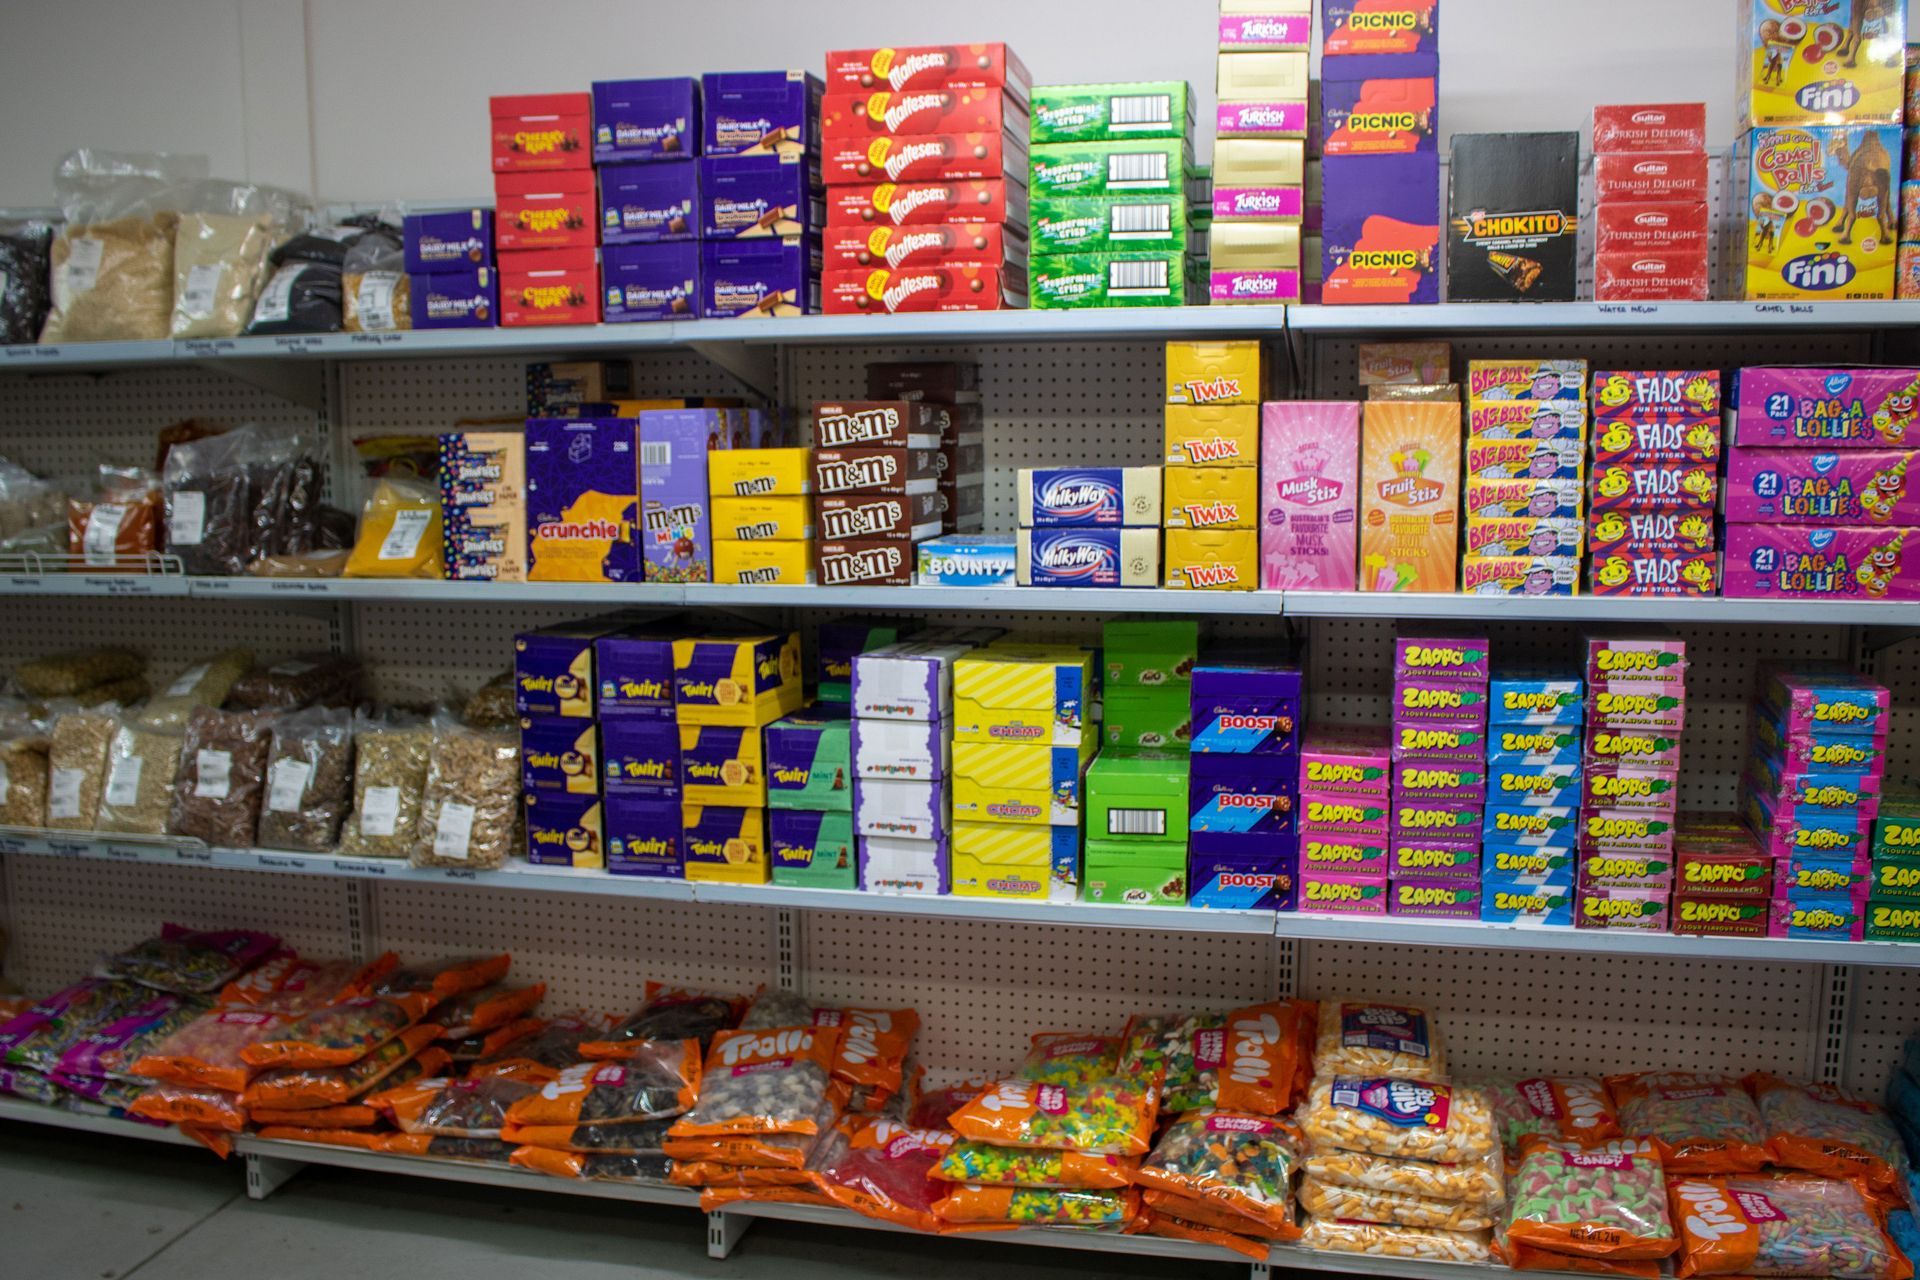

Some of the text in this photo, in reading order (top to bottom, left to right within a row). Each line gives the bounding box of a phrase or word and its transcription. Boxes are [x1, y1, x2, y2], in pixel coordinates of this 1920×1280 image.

[1352, 13, 1414, 28] PICNIC
[888, 53, 945, 92] Maltesers
[1802, 82, 1852, 110] Fini
[884, 94, 942, 134] Maltesers
[1351, 115, 1413, 130] PICNIC
[514, 130, 565, 145] CHERRY
[616, 128, 662, 138] DAIRY MILK
[526, 141, 555, 154] RIPE
[1758, 139, 1820, 172] Camel
[884, 142, 942, 180] Maltesers
[1608, 179, 1696, 189] TURKISH DELIGHT
[1773, 164, 1825, 189] Balls
[520, 208, 570, 223] CHERRY
[888, 187, 945, 226] Maltesers
[1473, 215, 1559, 237] CHOKITO
[1608, 230, 1697, 240] TURKISH DELIGHT
[420, 242, 468, 252] DAIRY MILK
[884, 233, 942, 270] Maltesers
[1352, 253, 1414, 267] PICNIC
[1788, 256, 1848, 287] Fini
[524, 285, 571, 300] CHERRY
[882, 275, 938, 313] Maltesers
[427, 299, 475, 310] DAIRY MILK
[1756, 305, 1784, 313] CAMEL
[1187, 378, 1240, 402] Twix
[1471, 367, 1530, 396] BIG BOSS
[1636, 378, 1682, 403] FADS
[1770, 396, 1788, 410] 21
[1801, 400, 1863, 418] BAG A
[1471, 406, 1531, 434] BIG BOSS
[1770, 410, 1788, 418] Pack
[1637, 424, 1683, 449] FADS
[1795, 418, 1874, 438] LOLLIES
[1185, 438, 1238, 462] Twix
[1470, 445, 1530, 473] BIG BOSS
[1282, 477, 1338, 504] Musk Stix
[1382, 477, 1439, 504] Fruit Stix
[1634, 469, 1681, 495] FADS
[1759, 474, 1776, 488] 21
[1789, 479, 1851, 496] BAG A
[1469, 484, 1528, 511] BIG BOSS
[1758, 488, 1776, 496] Pack
[1185, 502, 1238, 527] Twix
[1784, 496, 1862, 516] LOLLIES
[540, 520, 617, 538] crunchie
[1291, 524, 1328, 533] FAVOURITE
[1392, 525, 1428, 535] FAVOURITE
[1469, 523, 1529, 550] BIG BOSS
[1631, 514, 1678, 539] FADS
[1296, 535, 1323, 546] MUSK
[1756, 549, 1774, 563] 21
[1785, 554, 1847, 572] BAG A
[930, 558, 1009, 576] BOUNTY
[1185, 564, 1237, 588] Twix
[1465, 561, 1525, 589] BIG BOSS
[1634, 559, 1682, 583] FADS
[1780, 571, 1858, 591] LOLLIES
[1405, 646, 1464, 668] ZAPPO
[620, 680, 662, 699] Twirl
[682, 683, 713, 697] Twirl
[1403, 687, 1461, 709] ZAPPO
[1504, 692, 1556, 710] ZAPPO
[989, 726, 1043, 738] CHOMP
[1220, 716, 1276, 730] BOOST
[1401, 729, 1460, 750] ZAPPO
[1502, 732, 1554, 751] ZAPPO
[625, 758, 664, 778] Twirl
[688, 763, 719, 778] Twirl
[774, 767, 808, 784] Twirl
[1307, 762, 1364, 782] ZAPPO
[1402, 768, 1460, 789] ZAPPO
[1501, 774, 1553, 792] ZAPPO
[987, 804, 1042, 816] CHOMP
[1220, 794, 1274, 808] BOOST
[1308, 802, 1364, 823] ZAPPO
[1399, 808, 1457, 828] ZAPPO
[628, 838, 667, 856] Twirl
[690, 841, 722, 856] Twirl
[778, 845, 812, 862] Twirl
[1307, 842, 1363, 863] ZAPPO
[1398, 848, 1455, 868] ZAPPO
[987, 879, 1040, 891] CHOMP
[1220, 874, 1274, 888] BOOST
[1306, 881, 1362, 901] ZAPPO
[1398, 886, 1456, 906] ZAPPO
[717, 1030, 813, 1065] Trolli
[841, 1011, 892, 1064] Trolli
[1230, 1013, 1280, 1083] Trolli
[1573, 1155, 1624, 1167] CANDY
[1677, 1181, 1747, 1240] Trolli
[1570, 1229, 1586, 1239] NET
